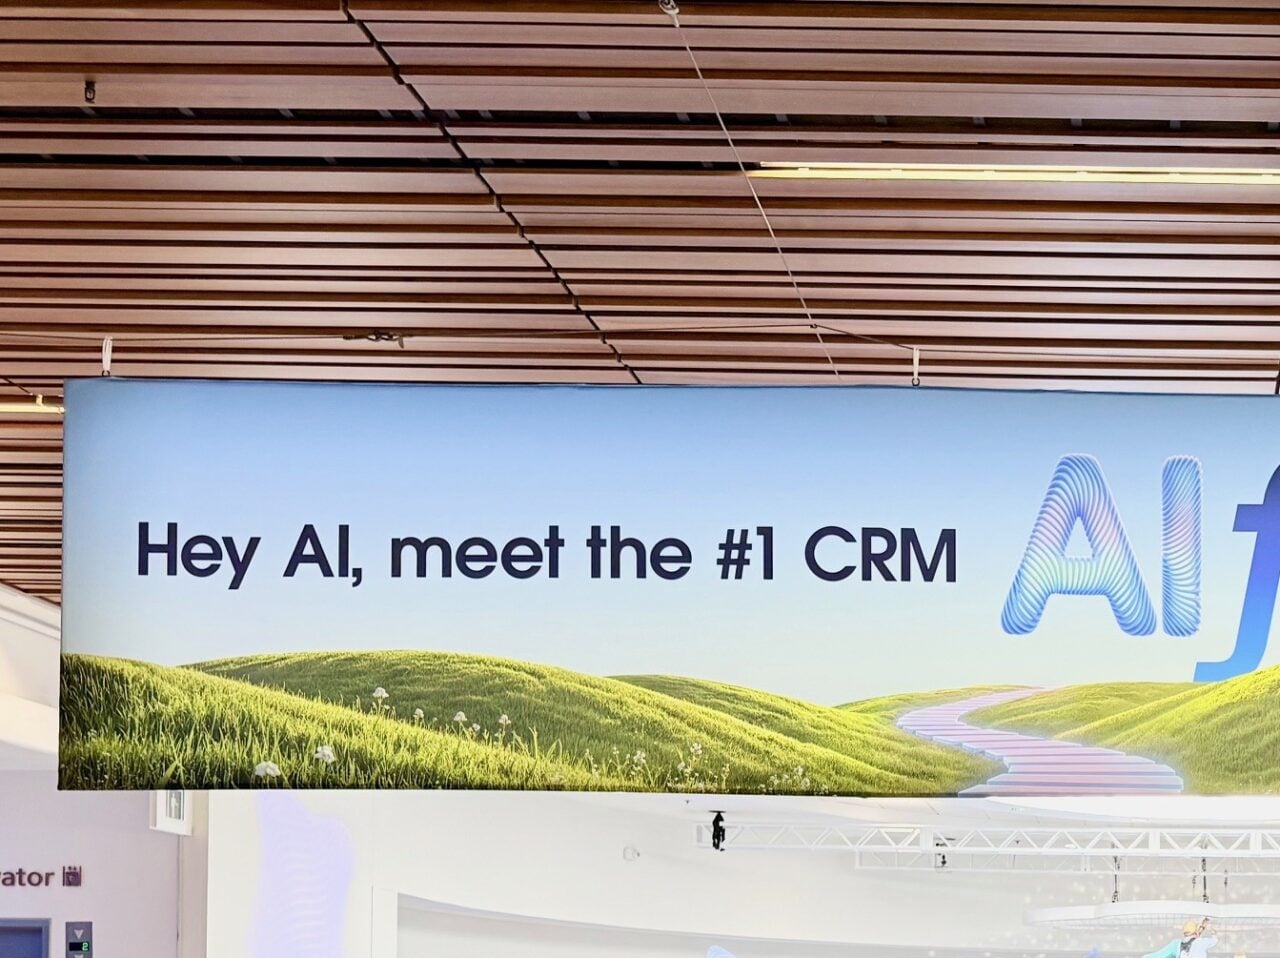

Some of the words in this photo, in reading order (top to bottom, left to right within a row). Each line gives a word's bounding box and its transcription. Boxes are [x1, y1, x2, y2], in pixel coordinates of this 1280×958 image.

[137, 521, 262, 590] Hey
[282, 524, 363, 588] AI,
[391, 525, 565, 580] meet
[586, 525, 693, 581] the
[716, 526, 774, 580] #1
[804, 525, 957, 583] CRM
[0, 867, 56, 887] ator
